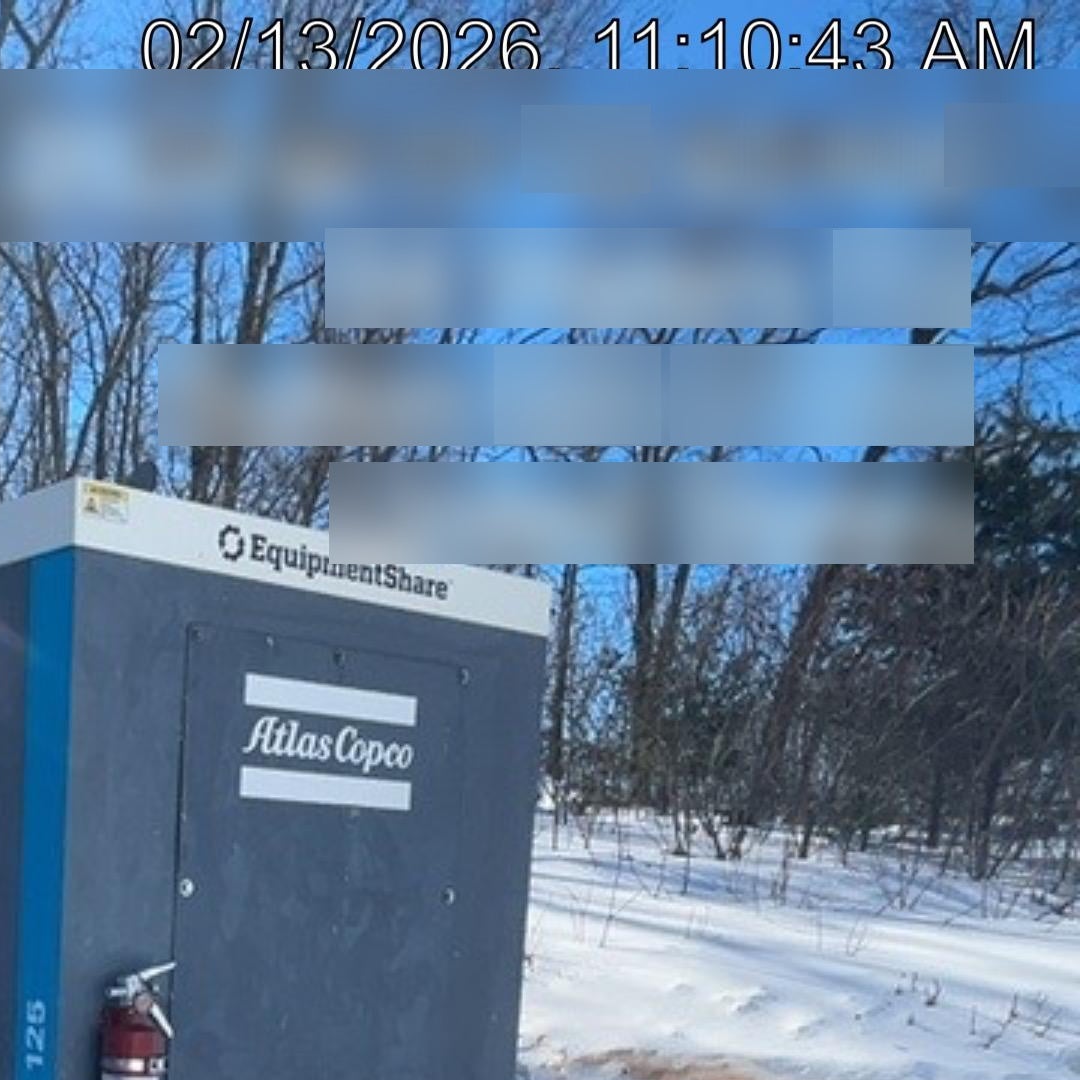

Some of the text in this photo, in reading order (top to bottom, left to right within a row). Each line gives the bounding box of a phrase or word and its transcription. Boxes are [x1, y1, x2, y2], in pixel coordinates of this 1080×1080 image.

[249, 533, 449, 600] EquipmentShare
[242, 716, 414, 774] Atlas Copco
[25, 999, 46, 1071] 125
